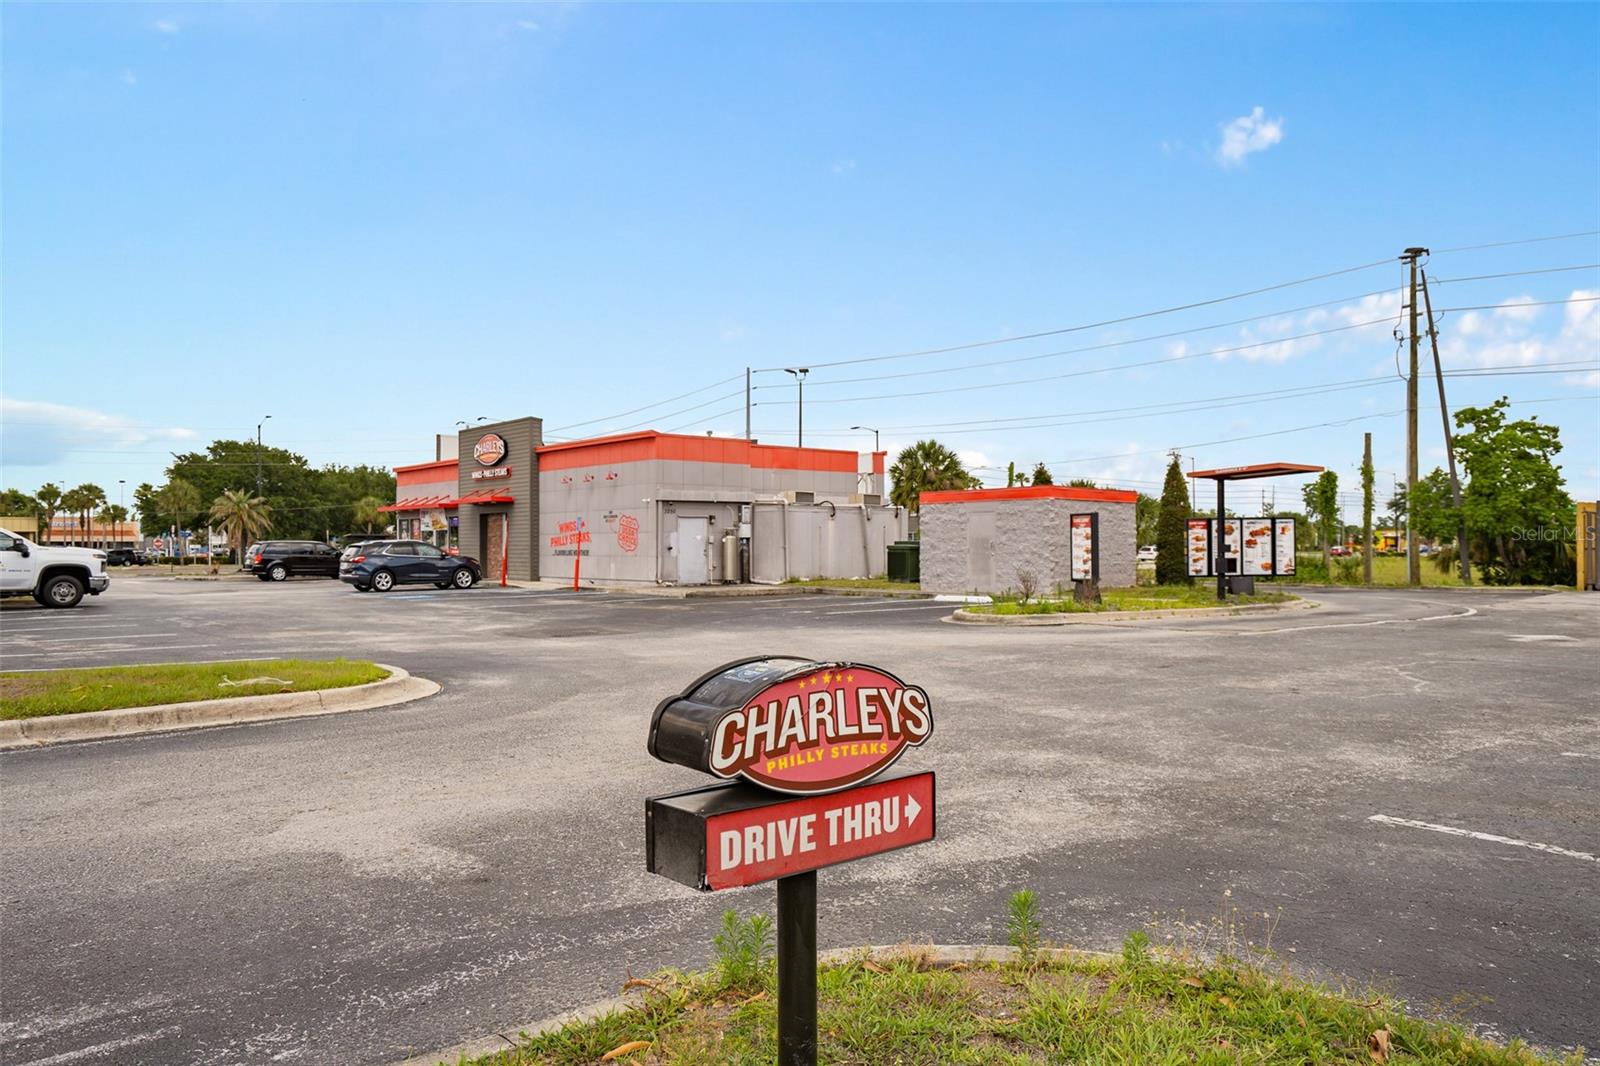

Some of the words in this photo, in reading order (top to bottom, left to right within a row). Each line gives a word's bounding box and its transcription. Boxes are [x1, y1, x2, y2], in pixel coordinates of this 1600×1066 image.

[474, 439, 505, 459] CHARLEYS
[711, 687, 931, 771] CHARLEYS
[766, 749, 825, 775] PHILLY
[831, 742, 888, 759] STEAKS
[719, 813, 817, 872] DRIVE
[824, 795, 900, 847] THRU
